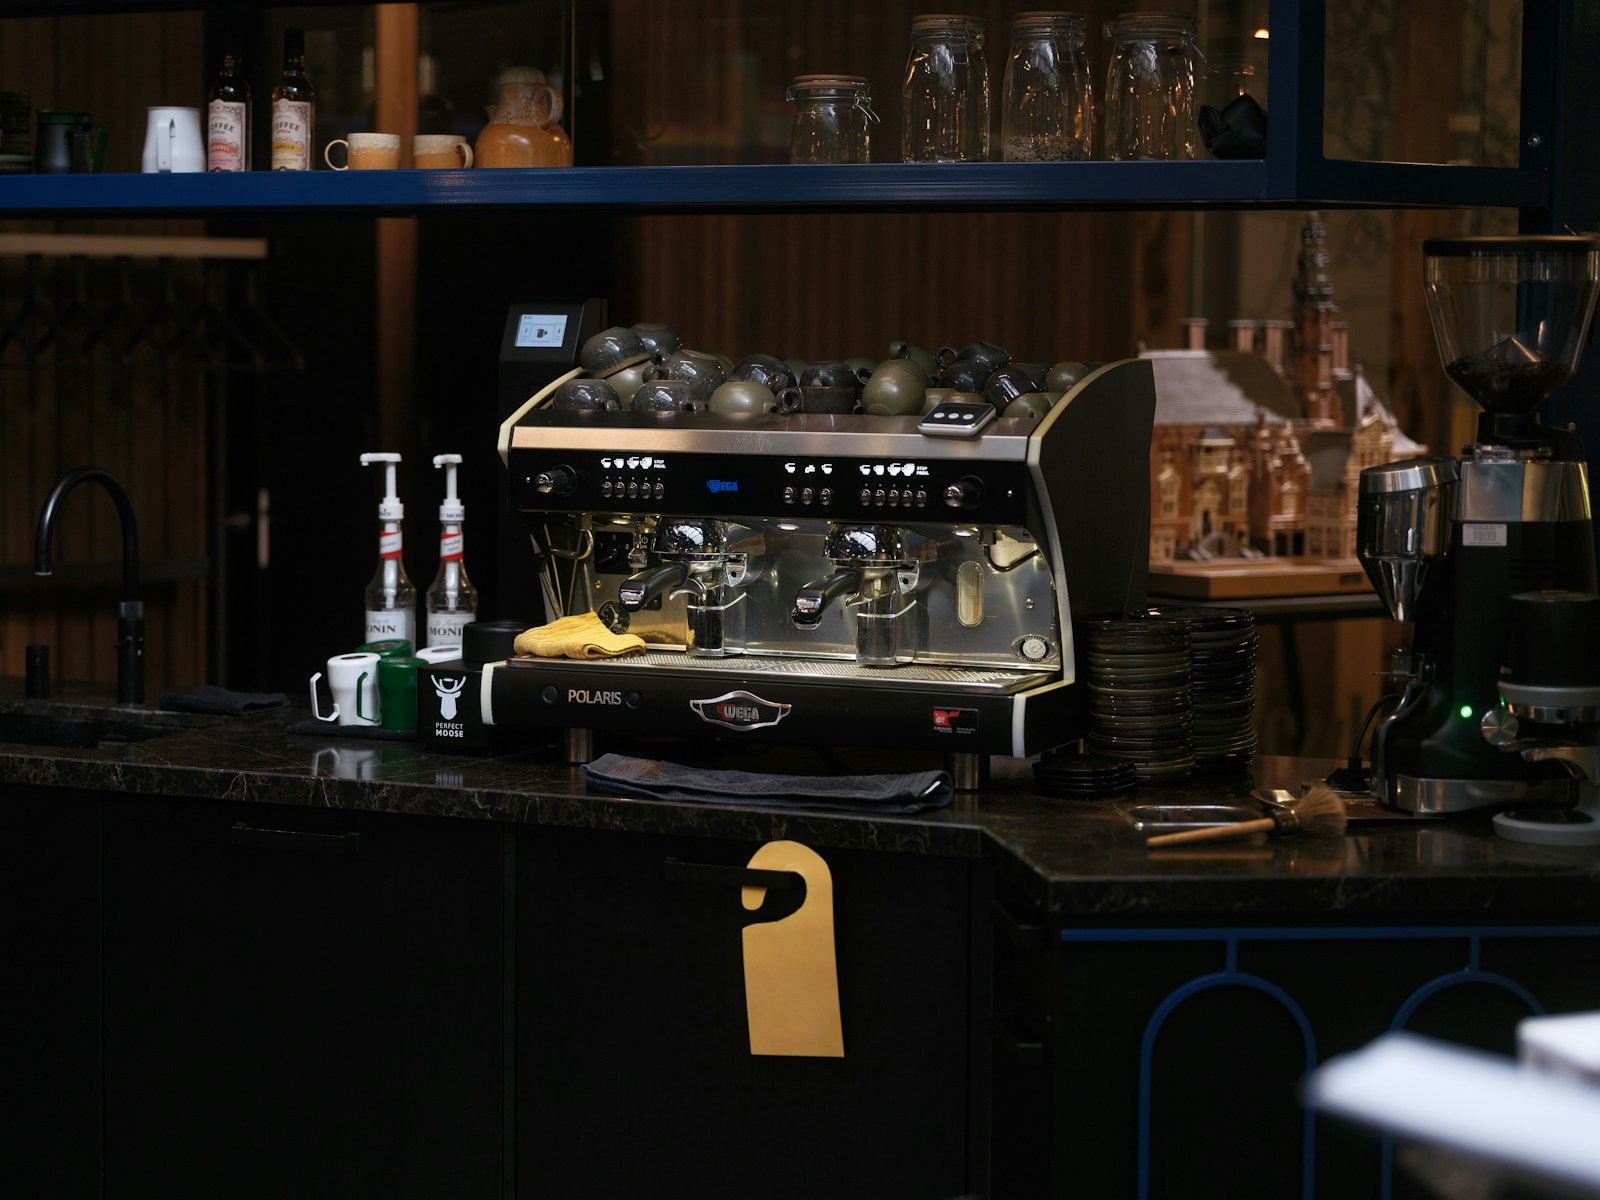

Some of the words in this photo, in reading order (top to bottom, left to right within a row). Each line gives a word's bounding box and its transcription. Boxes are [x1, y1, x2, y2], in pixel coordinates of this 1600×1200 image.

[209, 122, 235, 133] OFFEE
[273, 121, 300, 132] OFFEE
[708, 479, 738, 493] WEGA
[366, 624, 396, 634] ONIN
[430, 626, 462, 636] MONI
[567, 688, 622, 706] POLARIS
[723, 705, 760, 721] WEGA
[435, 722, 464, 730] PERFECT
[435, 729, 464, 738] MOOSE
